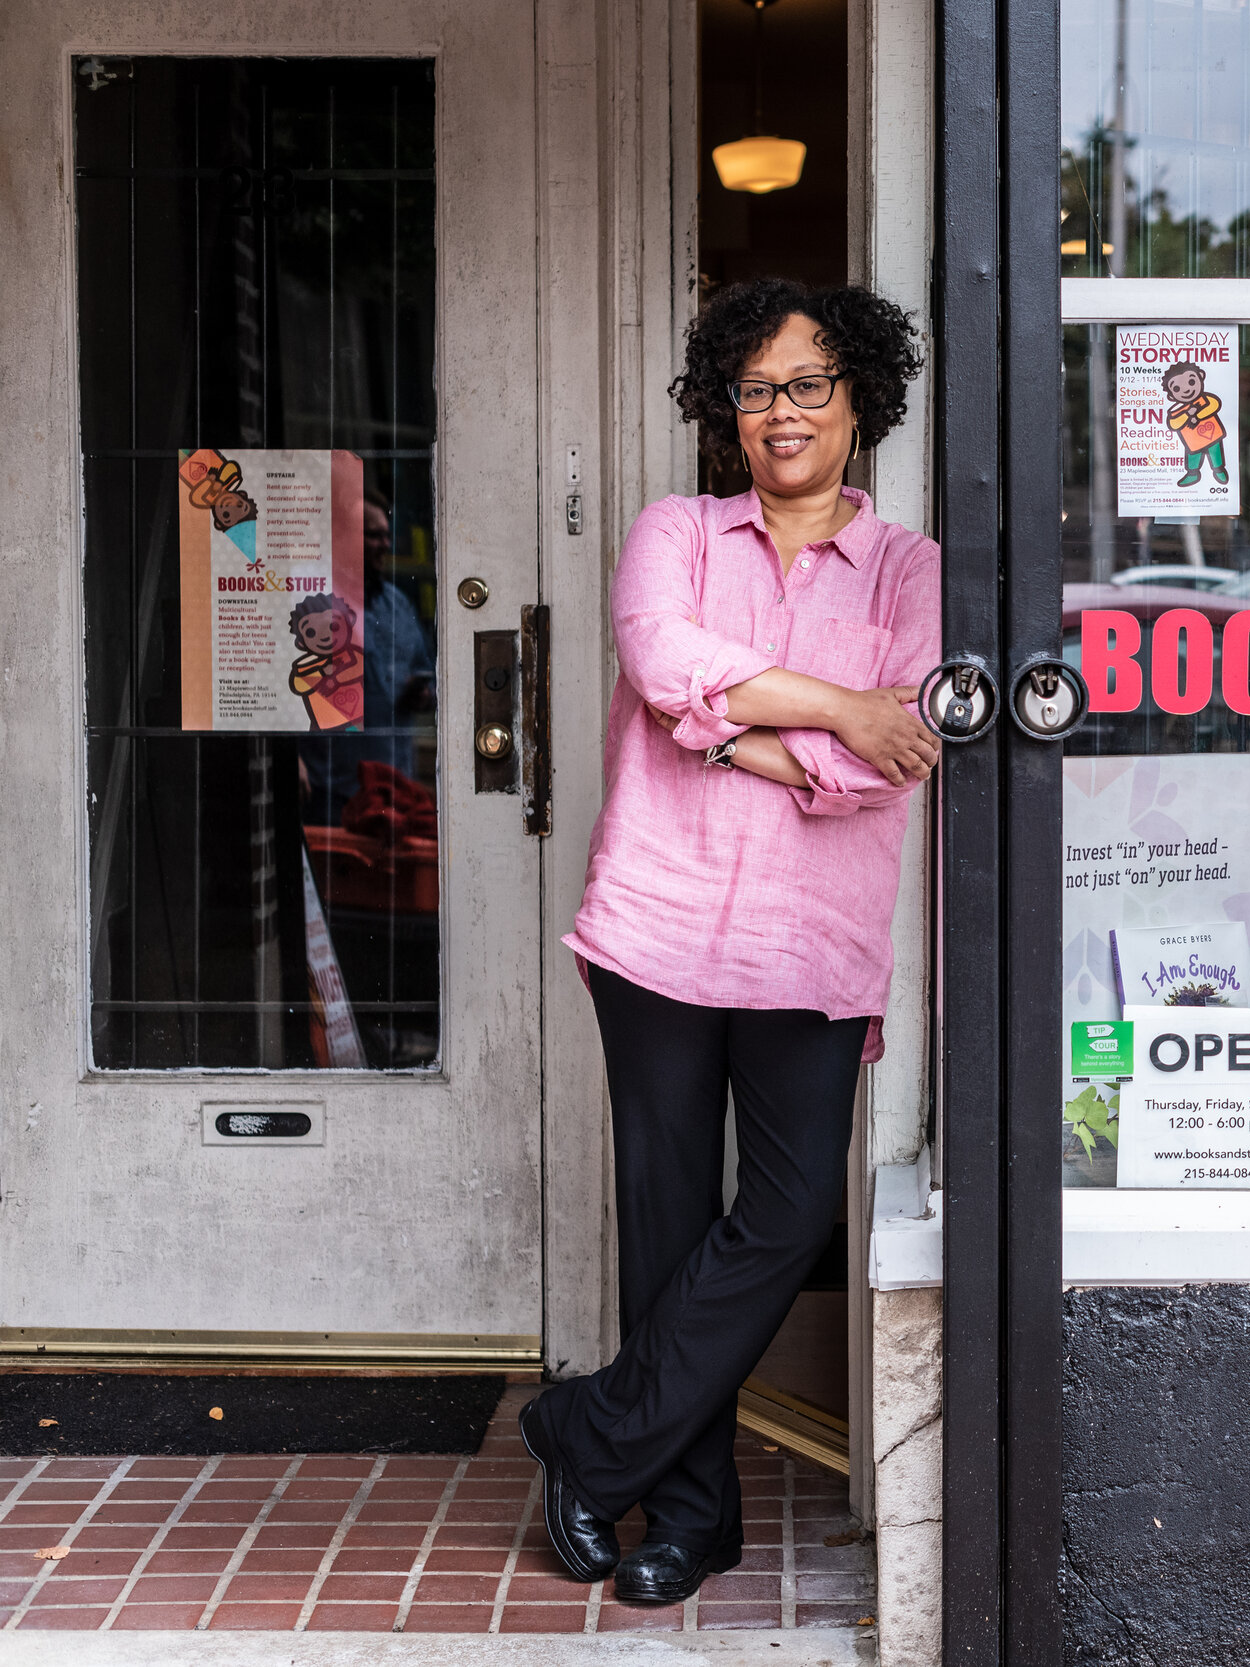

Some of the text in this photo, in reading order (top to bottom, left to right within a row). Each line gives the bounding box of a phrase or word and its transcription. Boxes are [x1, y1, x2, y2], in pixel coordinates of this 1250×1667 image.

[1120, 332, 1230, 347] WEDNESDAY
[1120, 348, 1230, 364] STORYTIME
[1133, 366, 1162, 374] Weeks
[1119, 376, 1162, 384] 9/12 11/14
[1119, 387, 1161, 398] Stories,
[1119, 398, 1164, 408] Songs and
[1120, 408, 1163, 424] FUN
[1120, 427, 1174, 441] Reading
[1120, 439, 1179, 451] Activities!
[1066, 844, 1112, 862] Invest
[1147, 844, 1183, 861] your
[1185, 838, 1218, 856] head
[1065, 872, 1089, 889] not
[1092, 868, 1121, 890] just
[1158, 870, 1193, 888] your
[1194, 863, 1231, 881] head.
[1160, 934, 1212, 946] GRACE BYERS
[1141, 953, 1241, 997] I Am Enough
[1093, 1042, 1116, 1050] TOUR
[1144, 1098, 1202, 1112] Thursday,
[1205, 1098, 1246, 1111] Friday,
[1168, 1117, 1205, 1129] 12:00
[1216, 1117, 1245, 1129] 6:00
